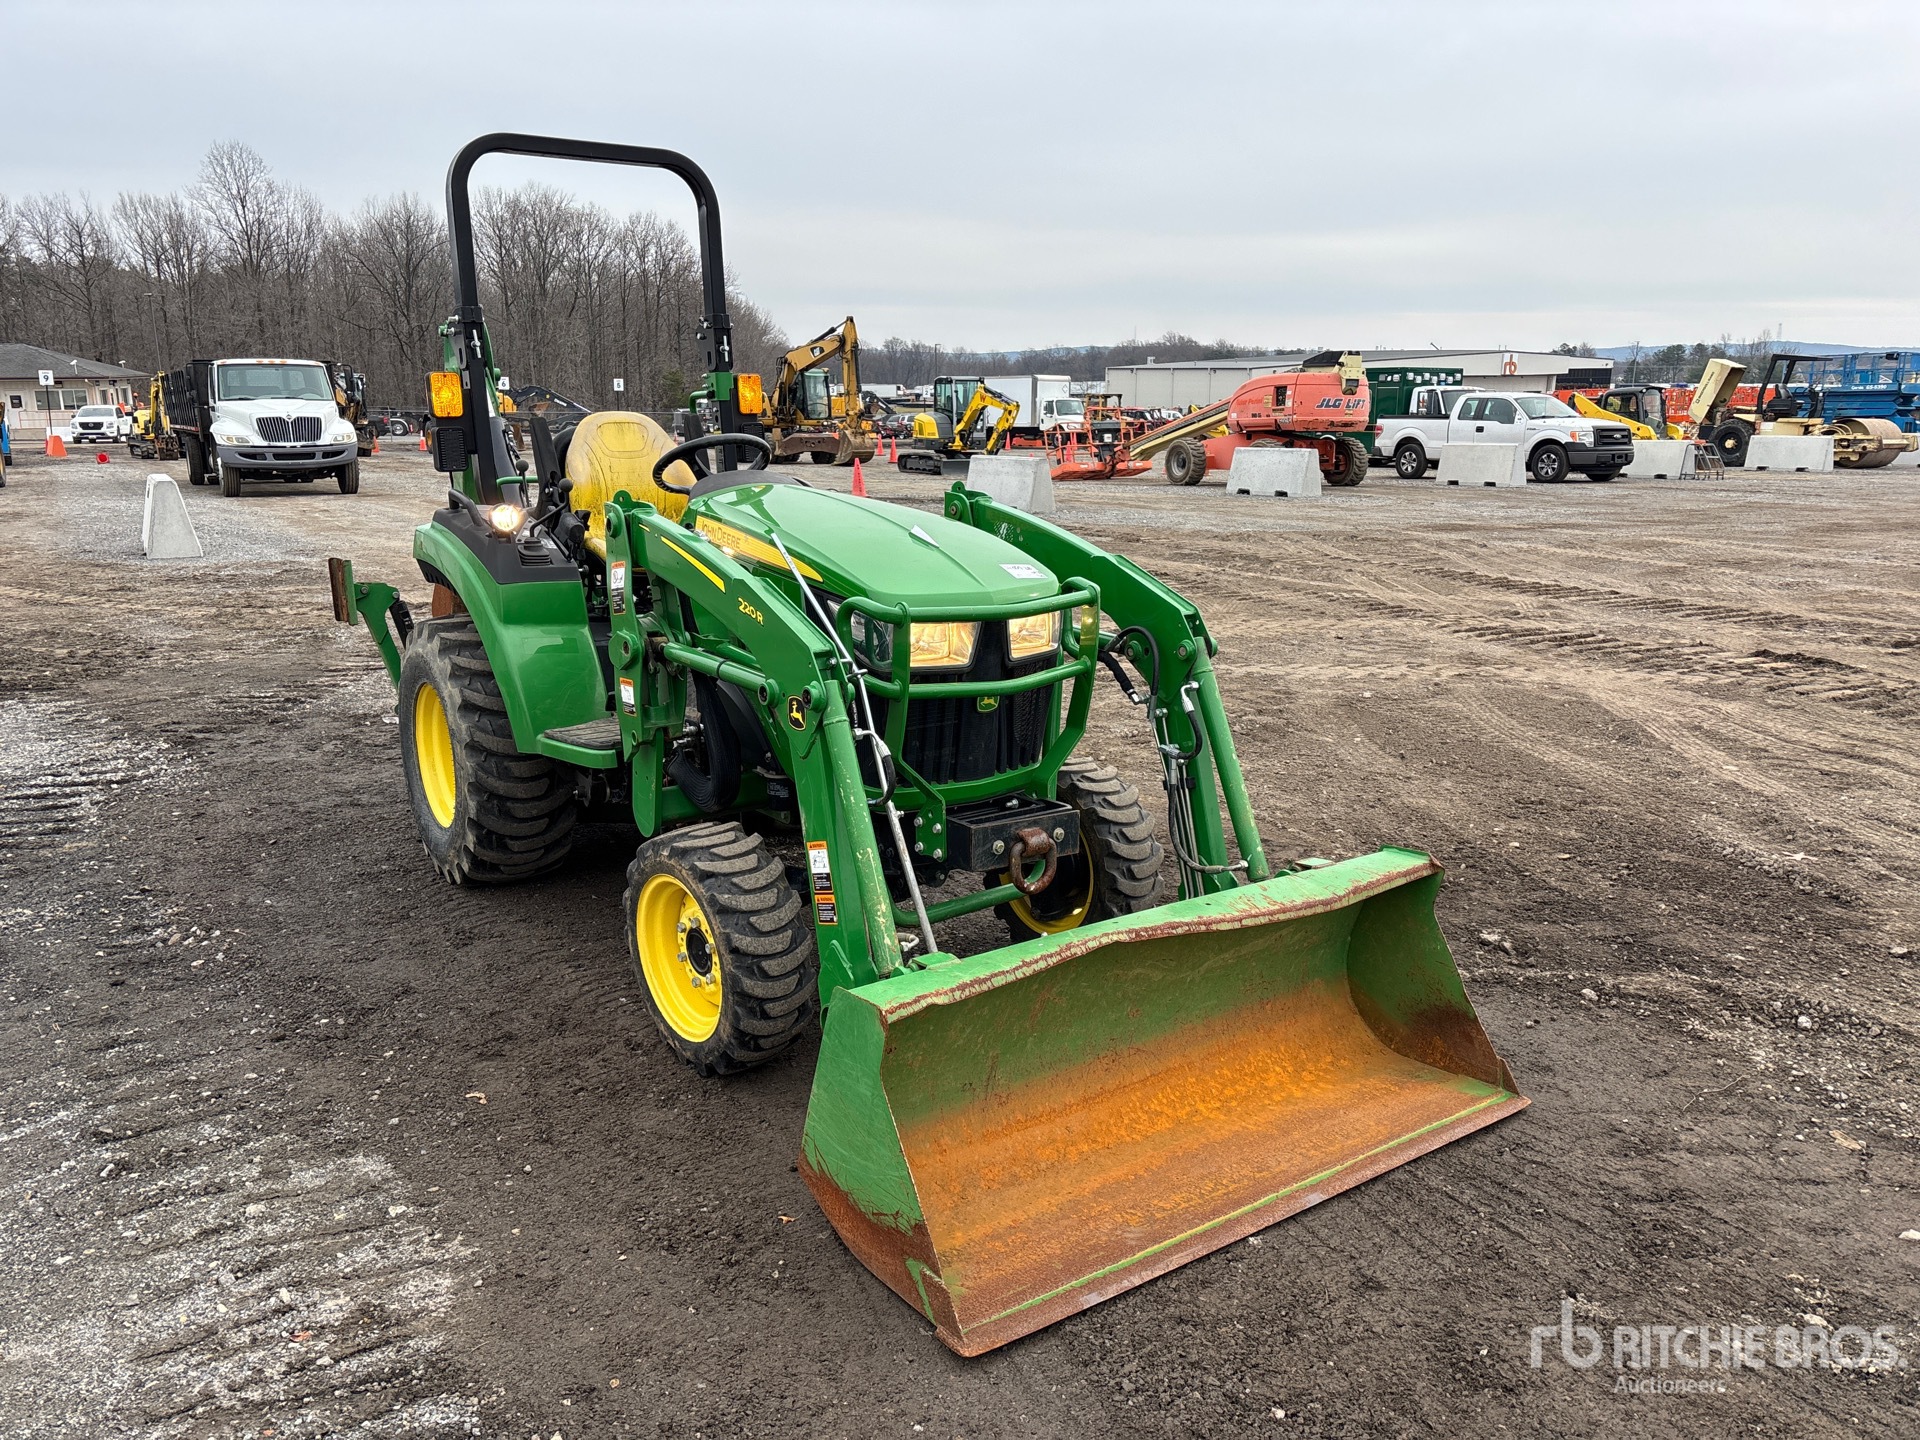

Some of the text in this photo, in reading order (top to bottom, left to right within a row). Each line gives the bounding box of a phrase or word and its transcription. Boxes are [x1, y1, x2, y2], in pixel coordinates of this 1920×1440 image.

[43, 374, 49, 382] 9
[1315, 397, 1365, 410] JLG LIFT
[717, 526, 741, 549] DEERE
